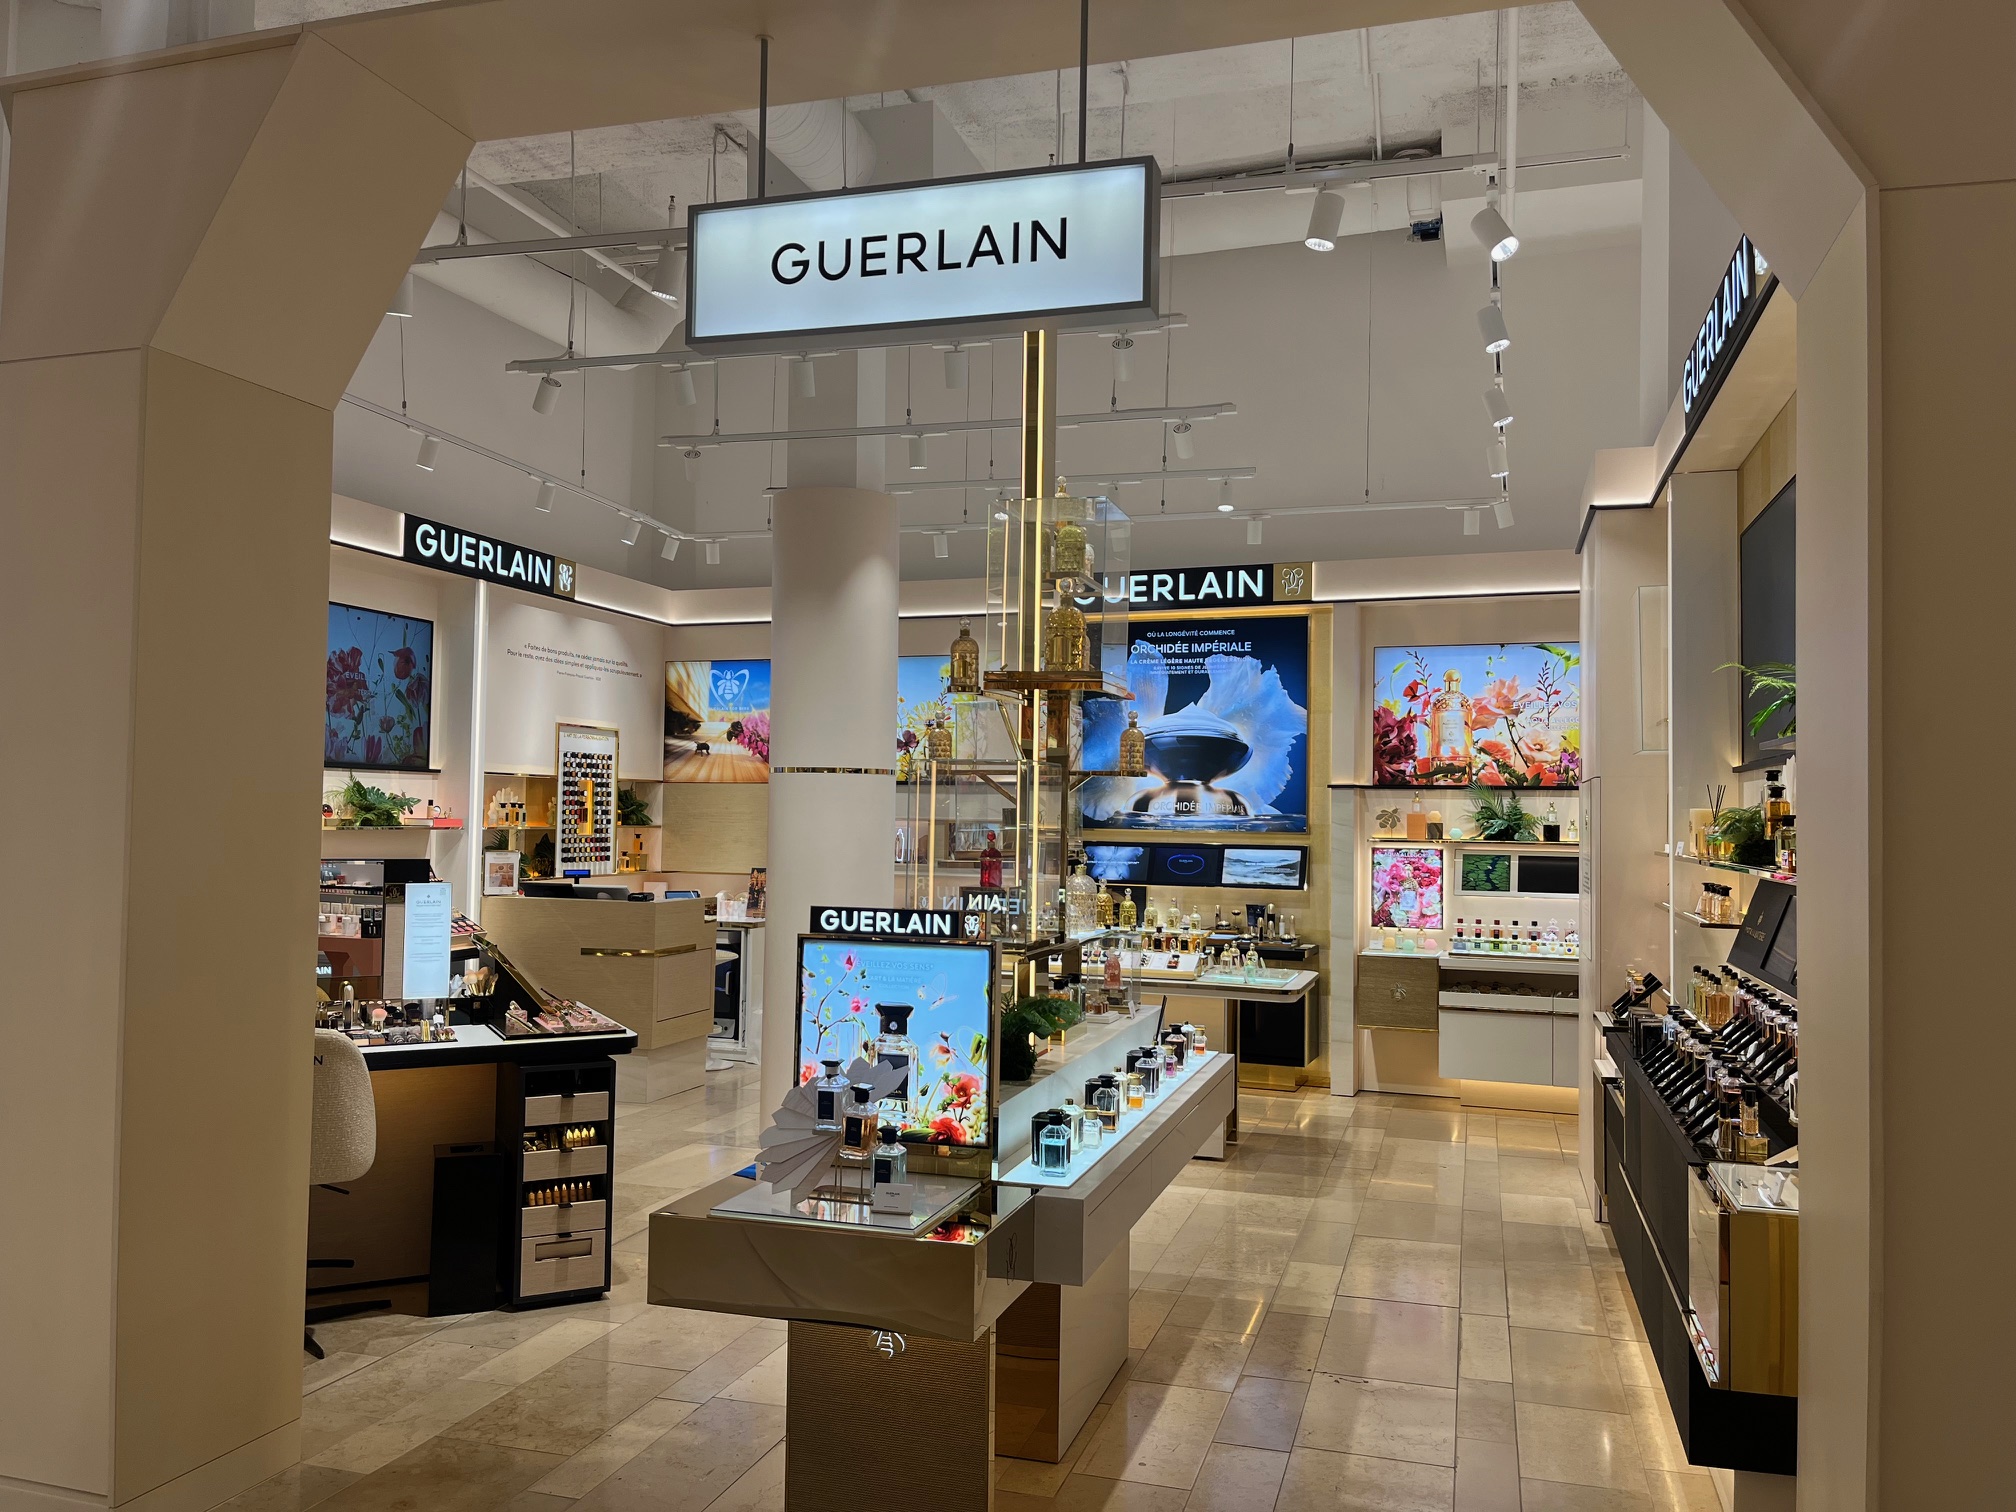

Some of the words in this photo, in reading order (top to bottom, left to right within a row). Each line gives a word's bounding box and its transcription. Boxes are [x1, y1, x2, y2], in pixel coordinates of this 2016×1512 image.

[771, 217, 1067, 285] GUERLAIN
[1683, 235, 1749, 413] GUERLAIN
[415, 524, 551, 587] GUERLAIN
[1074, 569, 1263, 605] UERLAIN
[507, 648, 517, 656] Pour
[1131, 641, 1189, 654] ORCHIDÉE
[1191, 640, 1251, 653] IMPÉRIALE
[820, 909, 950, 935] GUERLAIN
[892, 961, 908, 969] VOS
